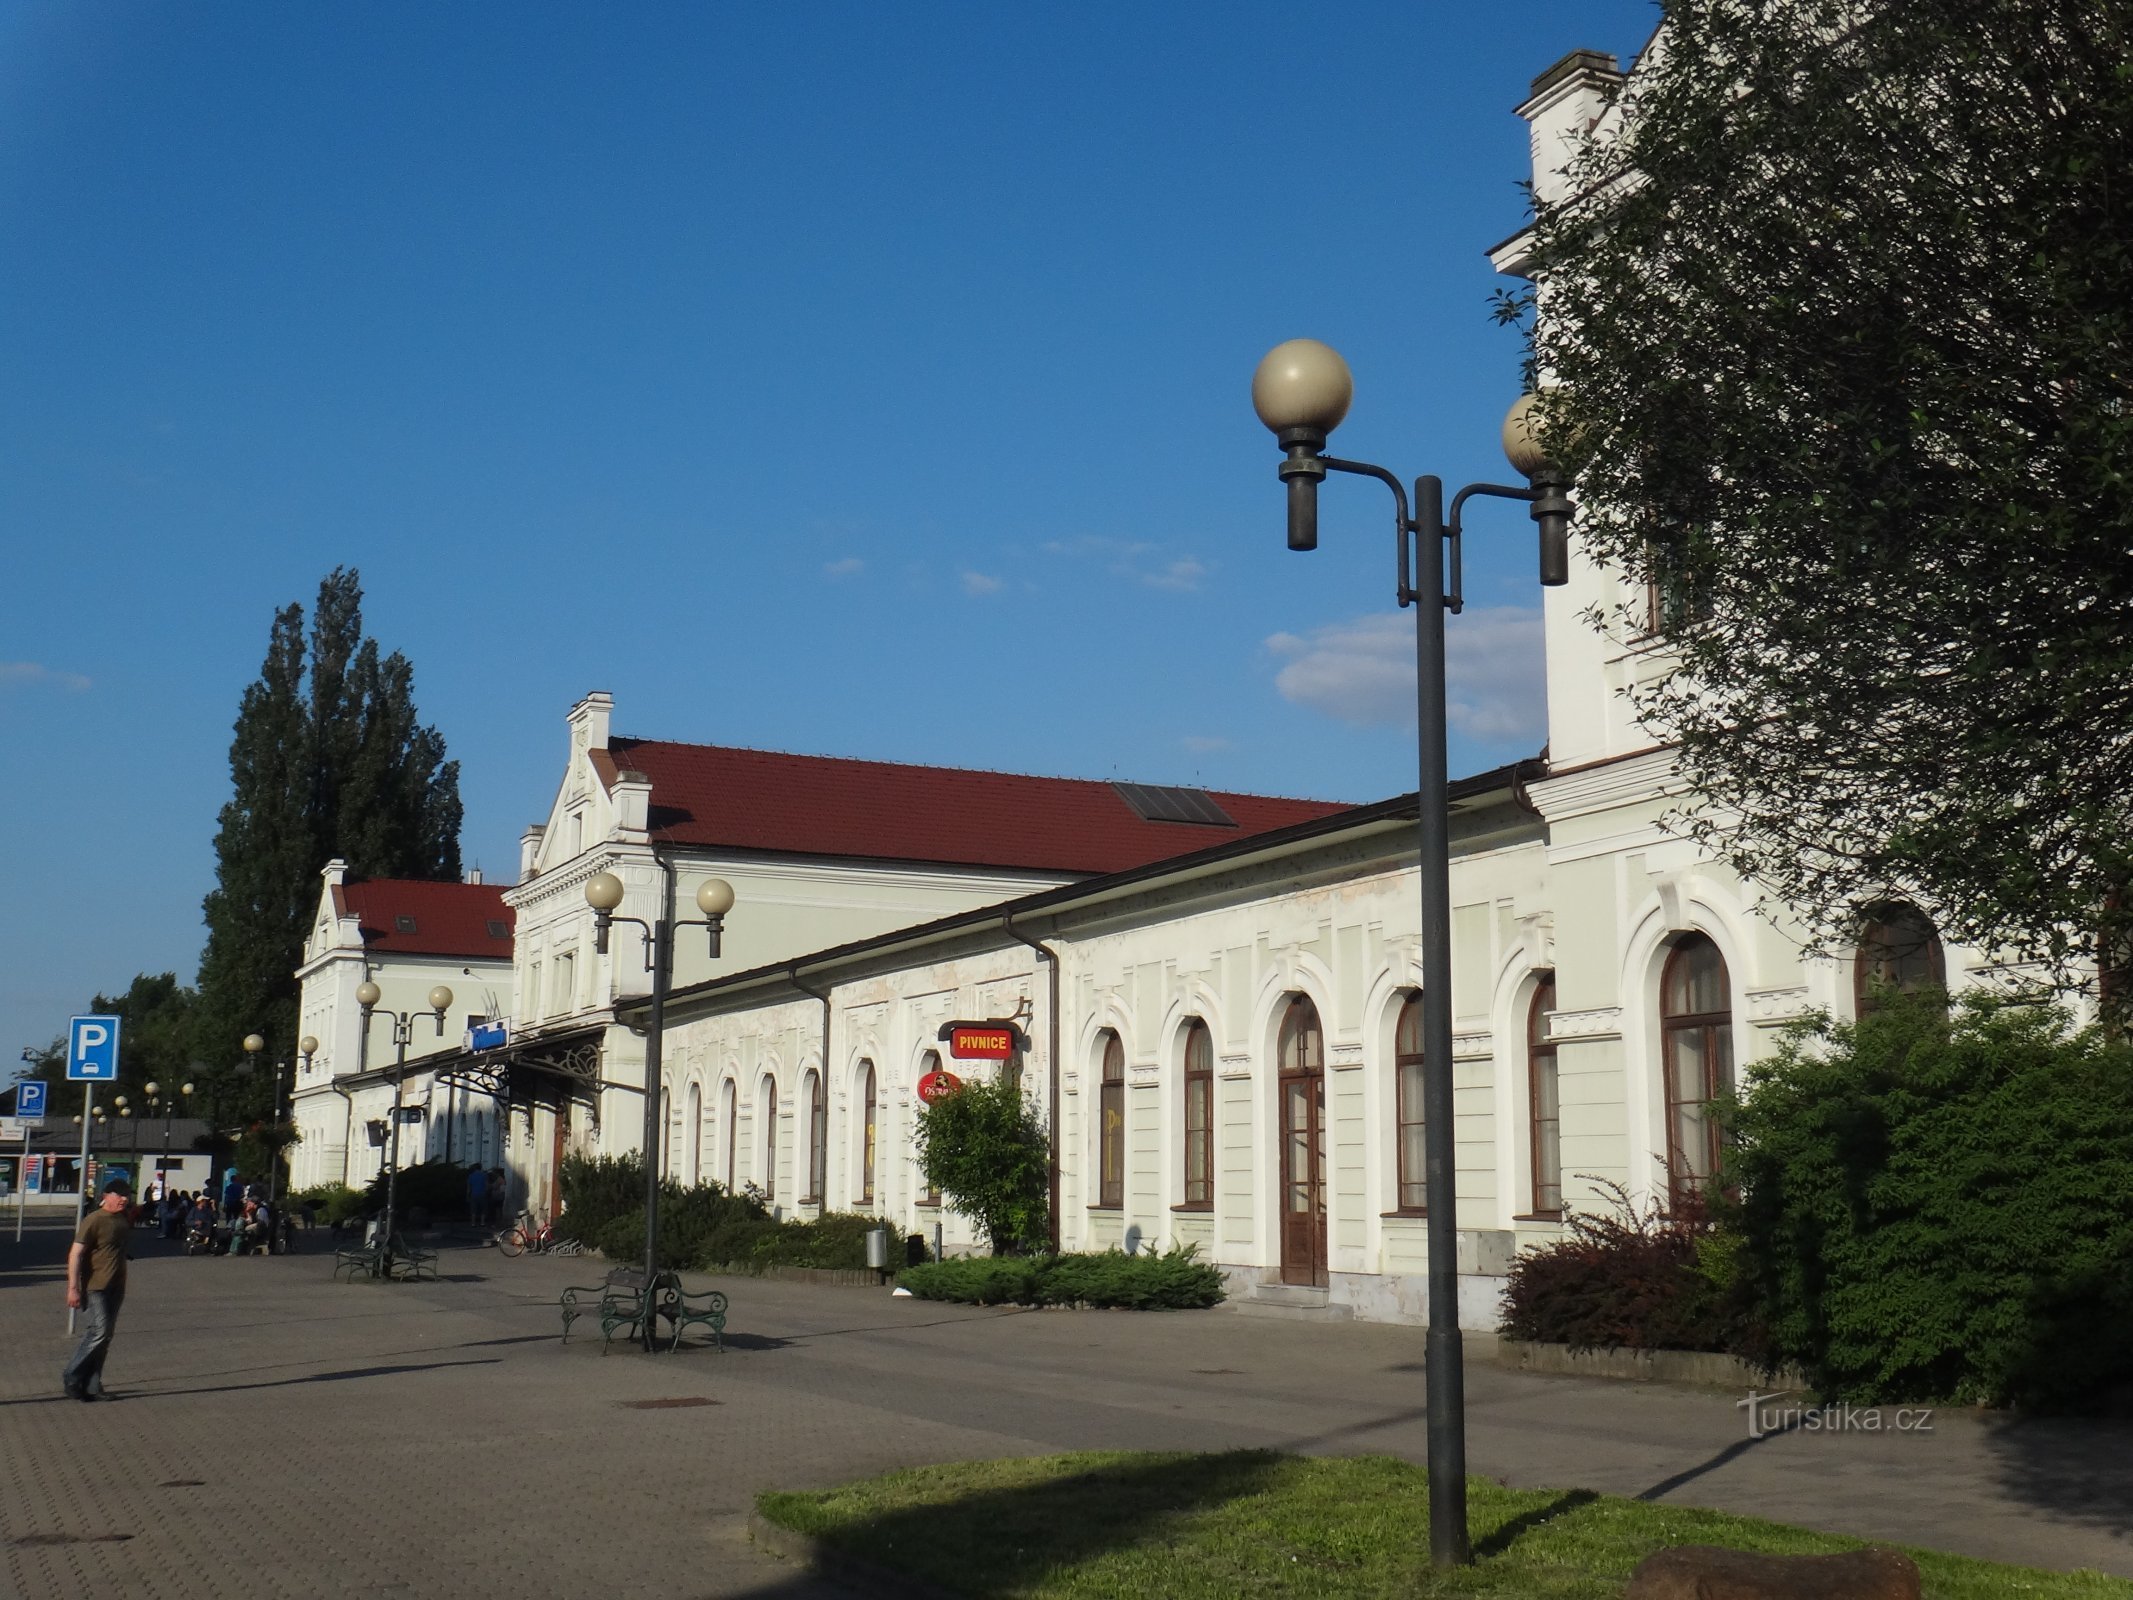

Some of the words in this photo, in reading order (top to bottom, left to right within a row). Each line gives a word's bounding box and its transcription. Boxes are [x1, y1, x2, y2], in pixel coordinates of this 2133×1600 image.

[78, 1024, 107, 1060] P
[959, 1036, 1007, 1049] PIVNICE
[22, 1085, 40, 1107] P
